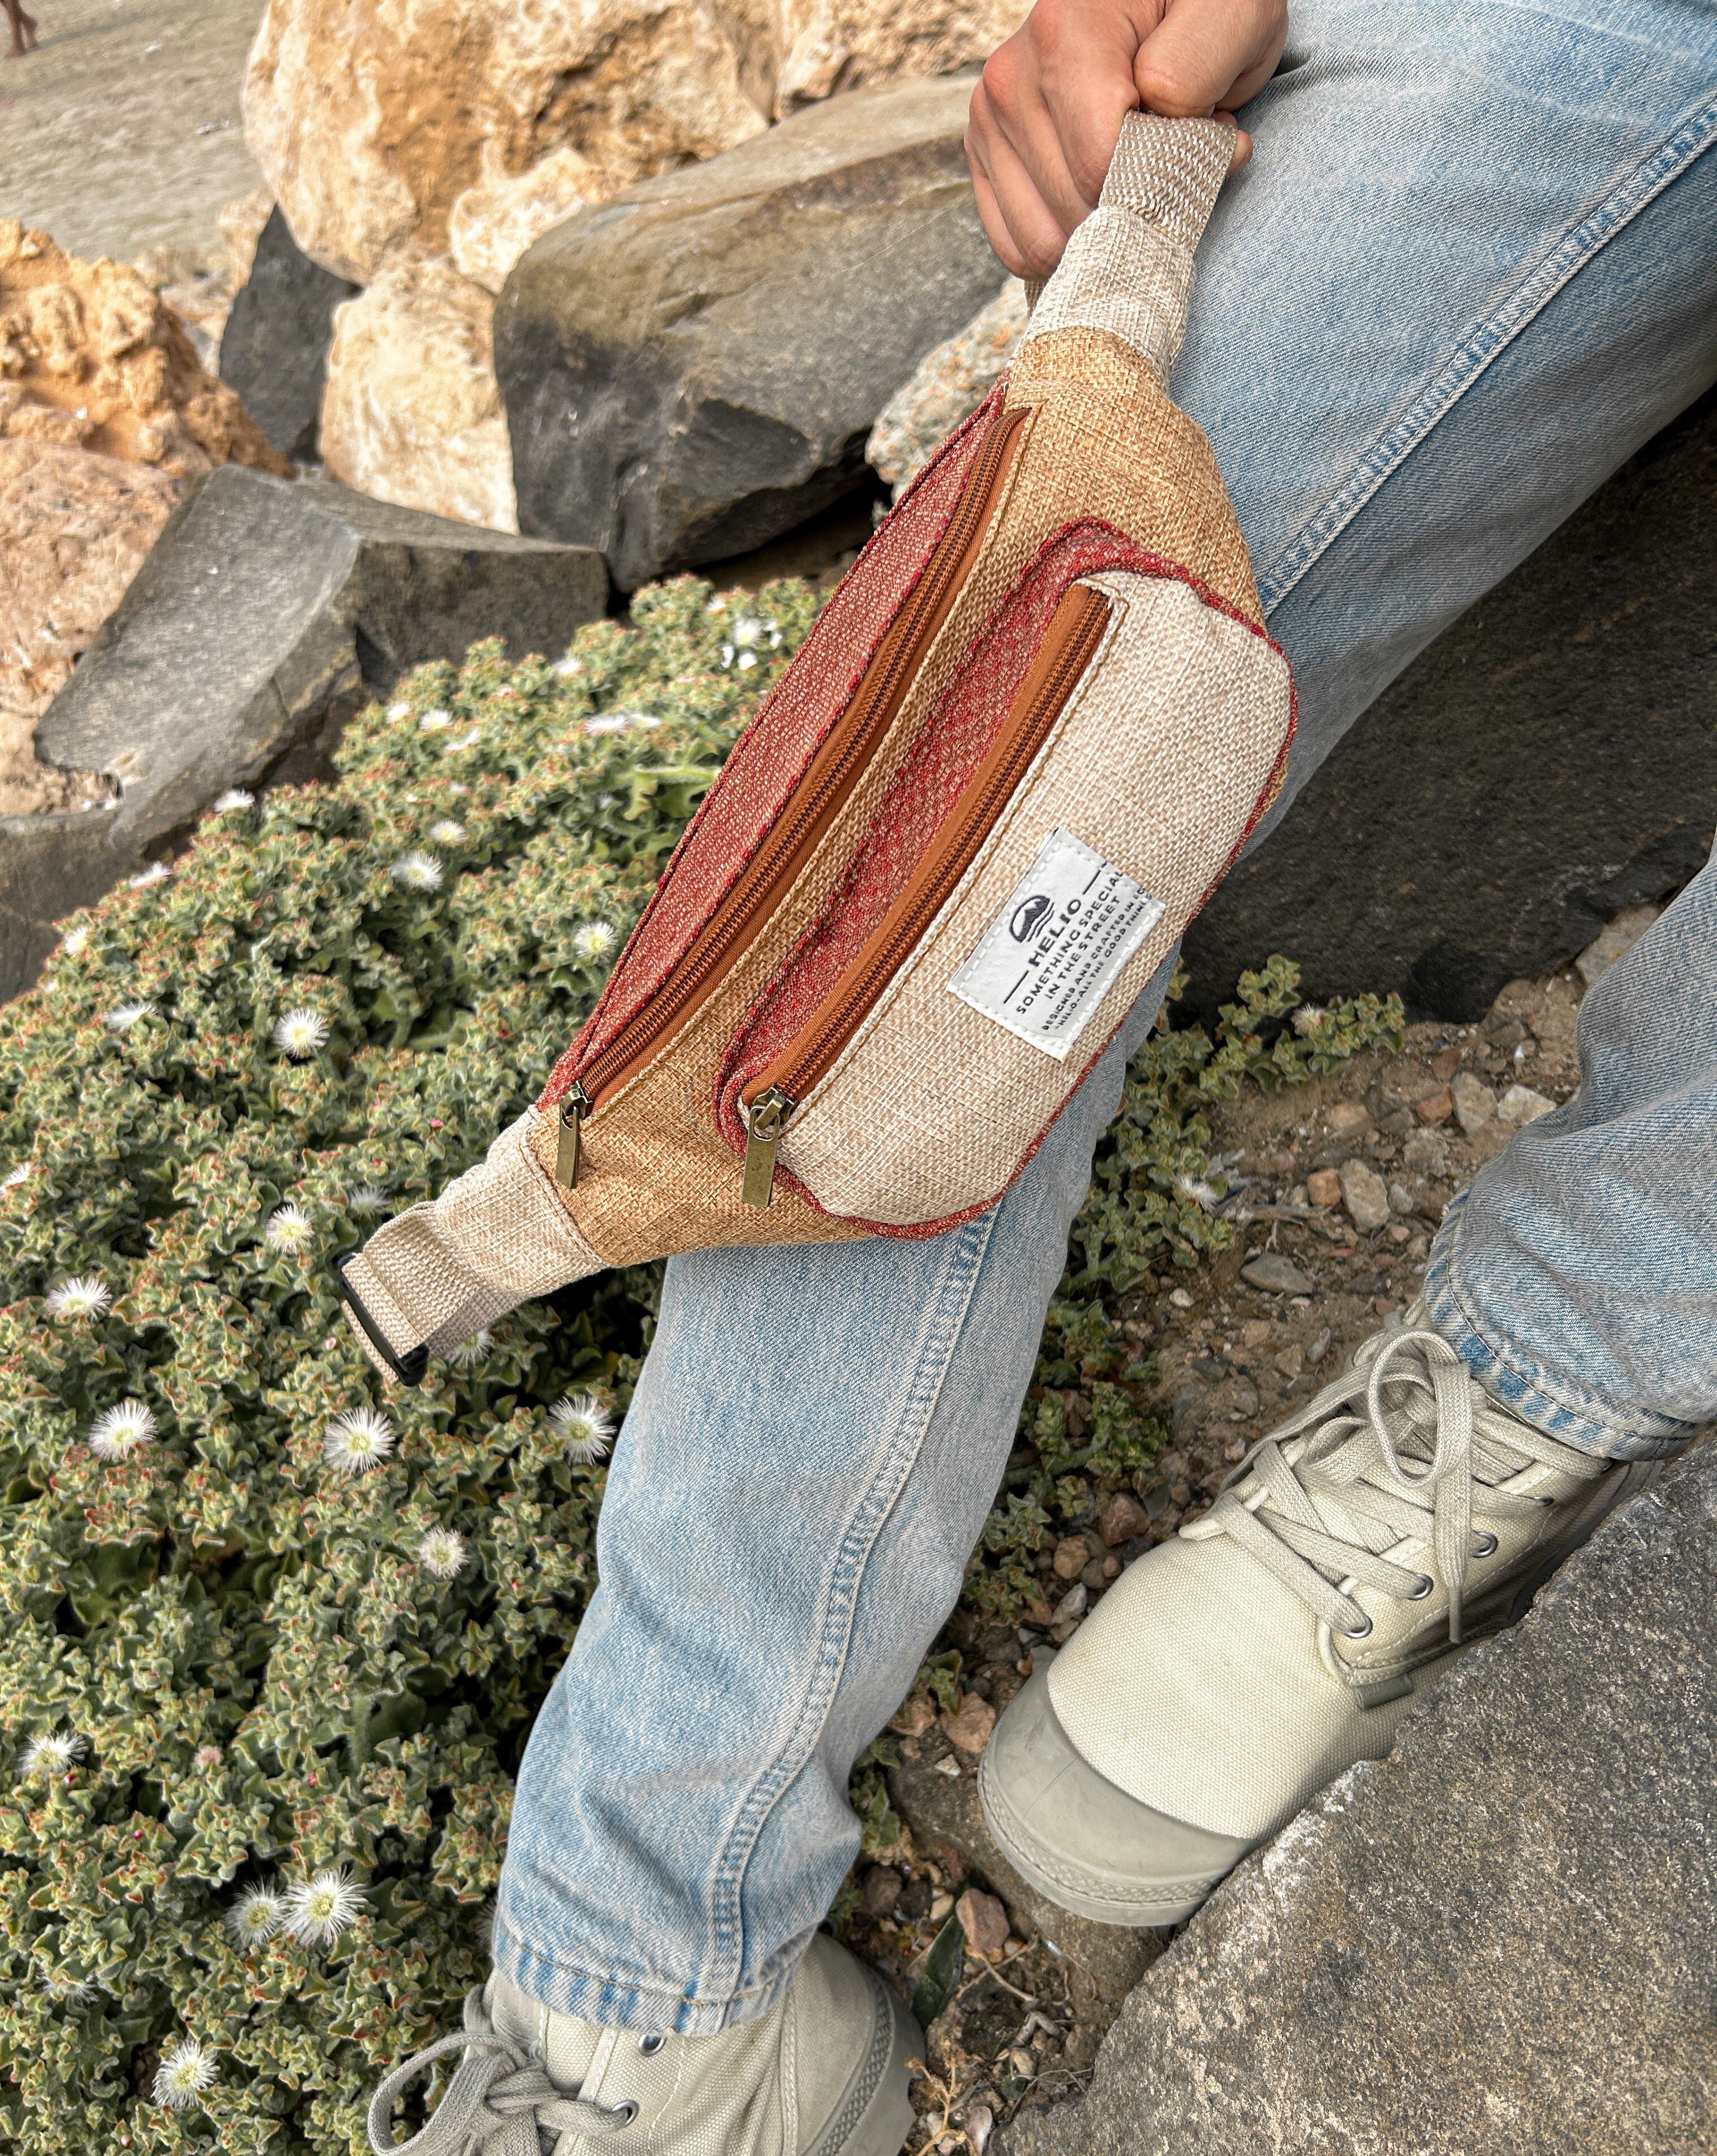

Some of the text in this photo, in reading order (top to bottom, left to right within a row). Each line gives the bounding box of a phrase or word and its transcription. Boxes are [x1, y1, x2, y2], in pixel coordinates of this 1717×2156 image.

[1016, 871, 1125, 1013] SOMETHING SPECIAL
[1028, 899, 1081, 967] HELIO
[1042, 988, 1075, 1030] DESIGNED
[1075, 963, 1091, 985] AND
[1091, 915, 1125, 959] CRAFTED
[1124, 901, 1134, 913] IN
[1046, 896, 1119, 999] IN THE STREET
[1090, 962, 1104, 978] THE
[1104, 928, 1126, 958] GOOD
